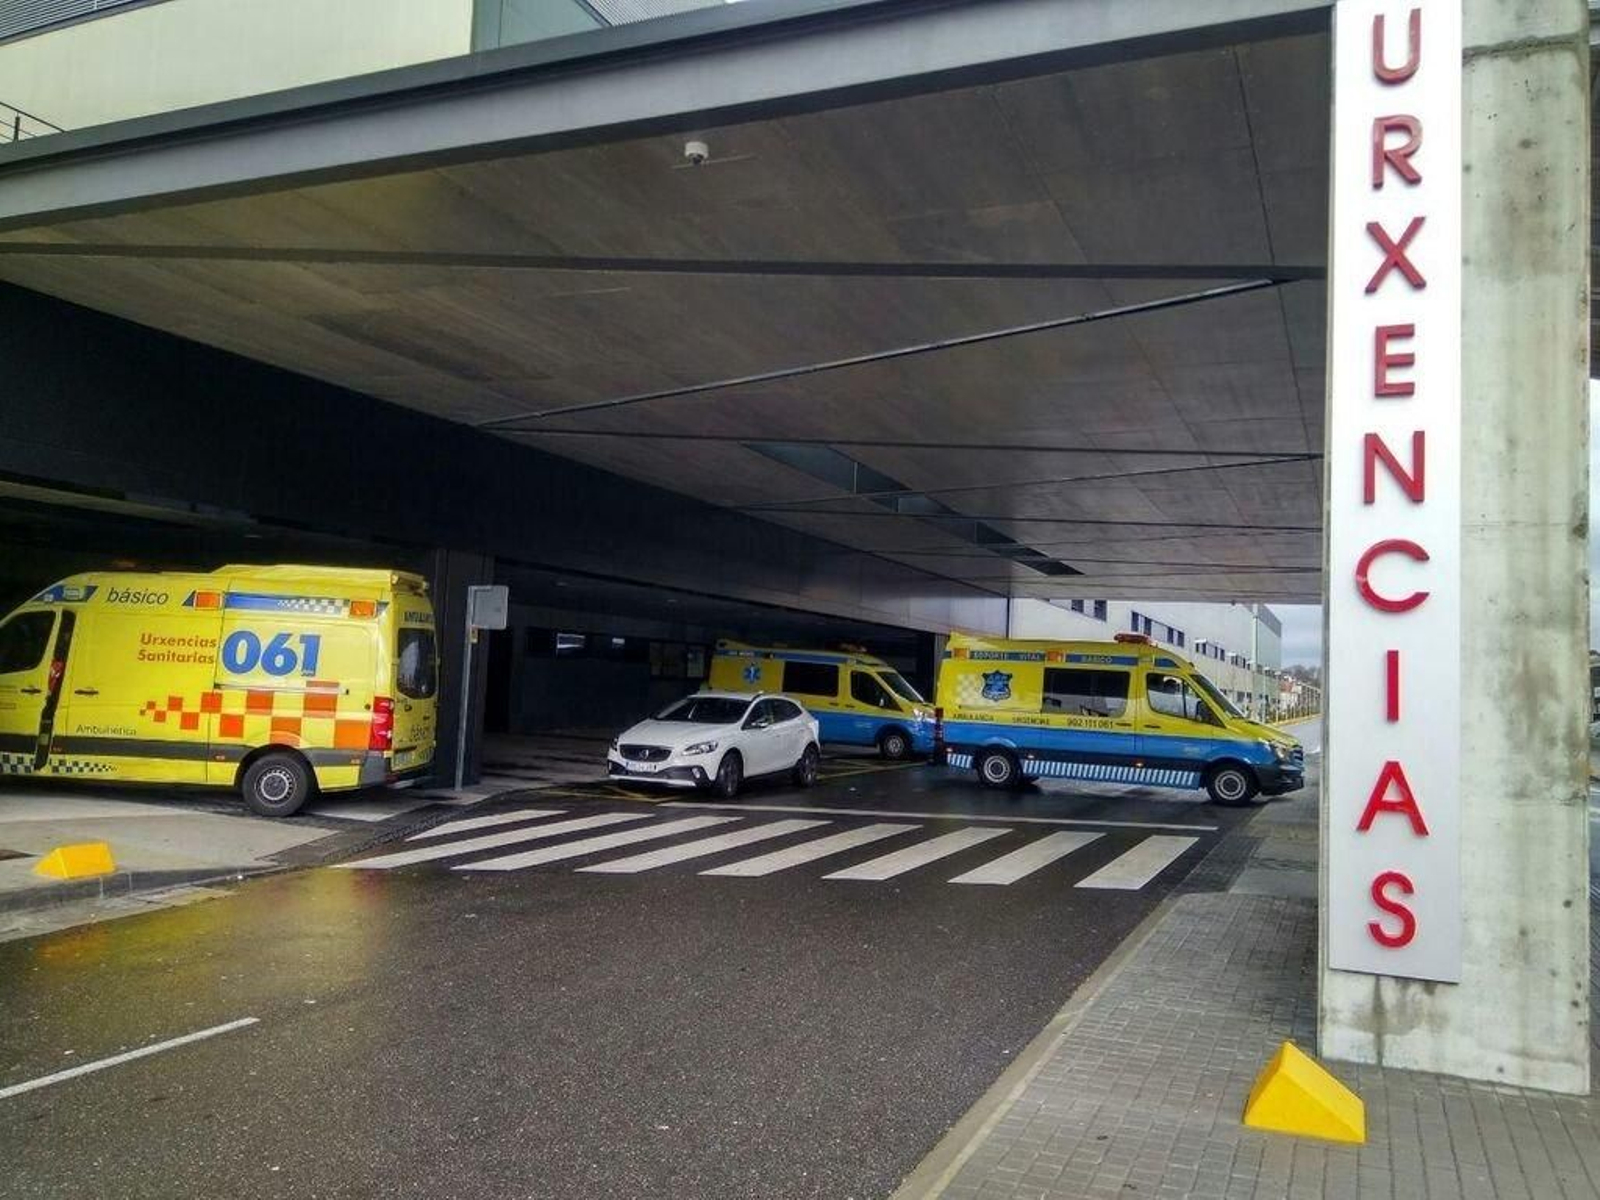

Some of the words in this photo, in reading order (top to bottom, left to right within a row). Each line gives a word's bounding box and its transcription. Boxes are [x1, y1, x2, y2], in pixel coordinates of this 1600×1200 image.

[1355, 8, 1431, 950] URXENCIAS
[106, 587, 169, 605] básico
[141, 633, 217, 648] Urxencias
[138, 649, 215, 665] Sanitarias
[222, 630, 321, 677] 061
